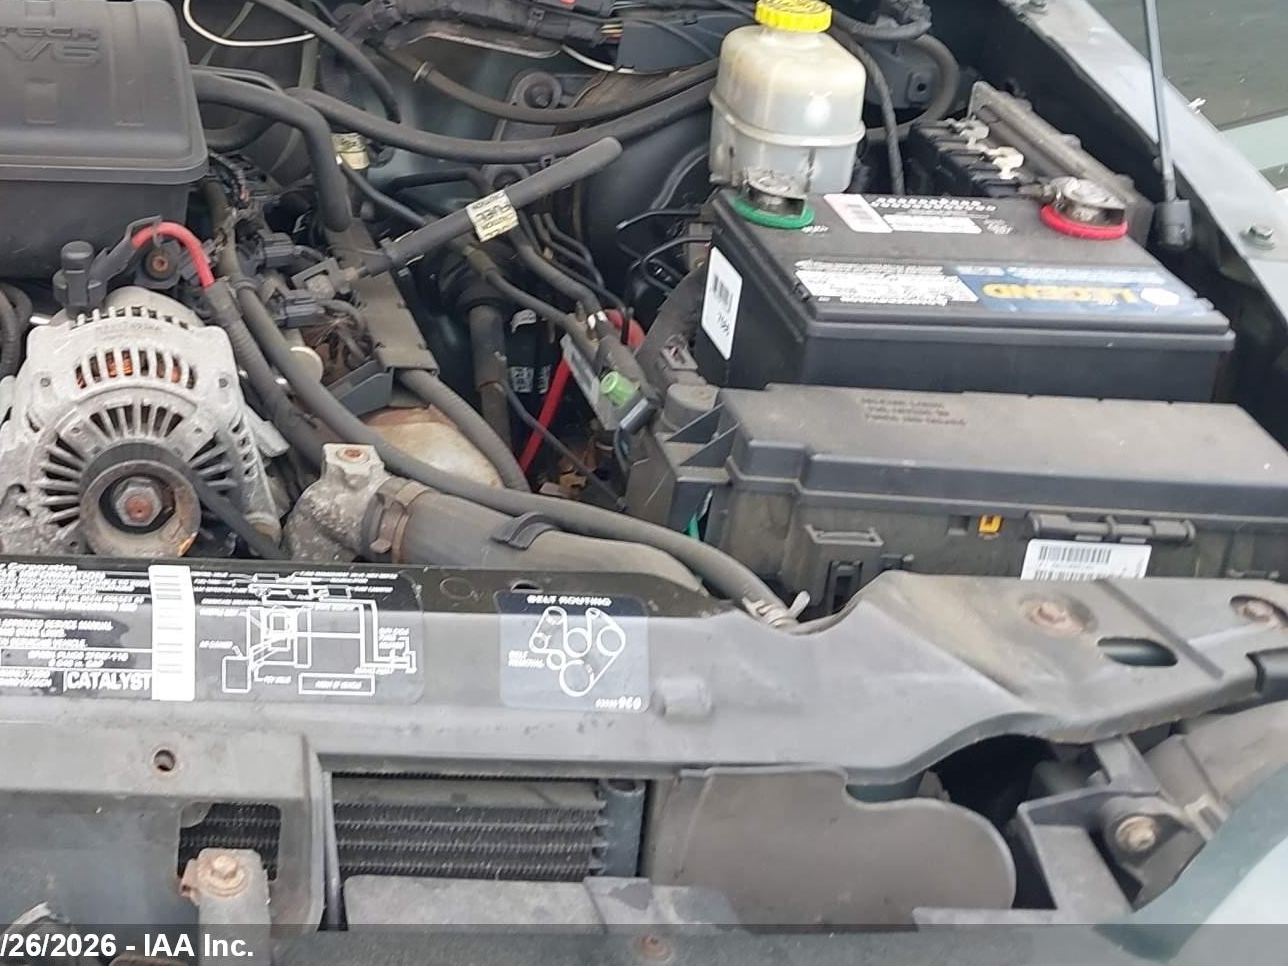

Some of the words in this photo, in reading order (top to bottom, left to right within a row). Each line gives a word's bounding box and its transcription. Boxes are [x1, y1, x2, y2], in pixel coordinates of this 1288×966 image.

[0, 39, 106, 66] V6
[527, 595, 557, 604] BELT
[559, 596, 612, 606] ROUTING
[67, 671, 152, 691] CATALYST
